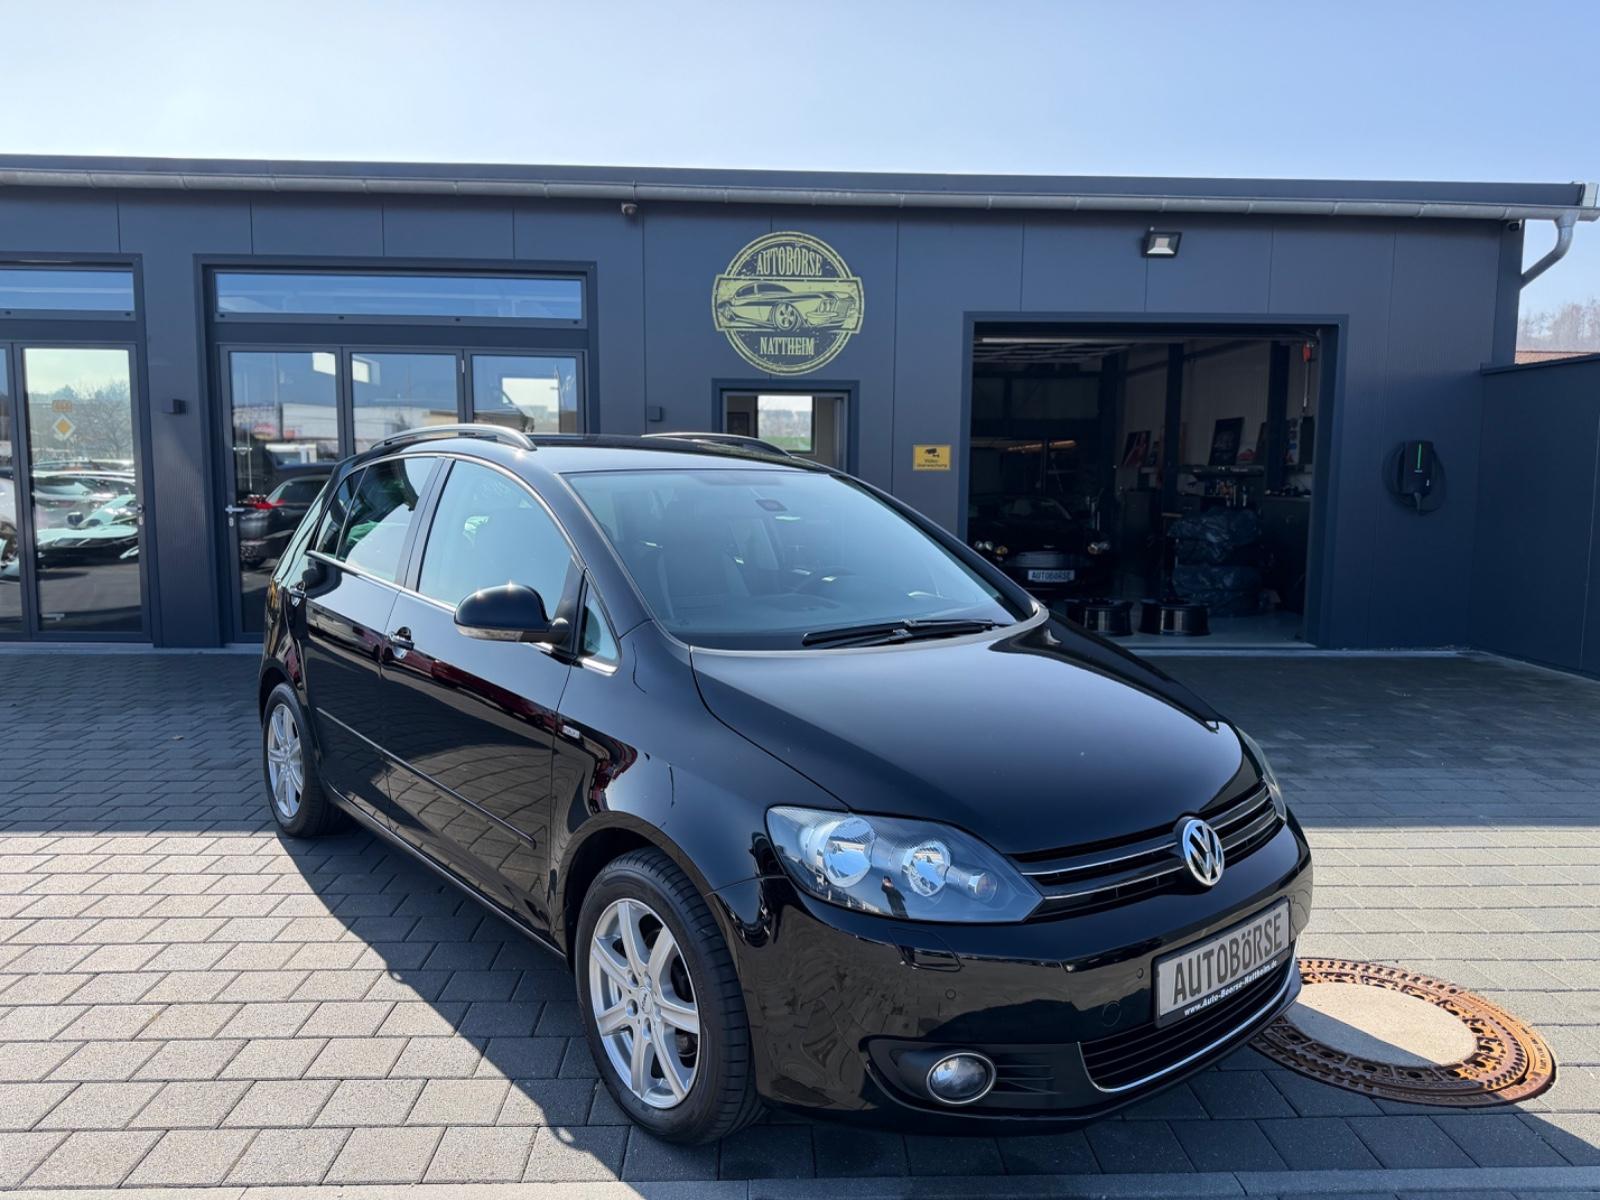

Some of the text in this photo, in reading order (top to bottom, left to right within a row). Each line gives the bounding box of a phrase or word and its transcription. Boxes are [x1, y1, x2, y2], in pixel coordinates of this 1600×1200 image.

[760, 336, 815, 355] NATTHEIM
[1173, 912, 1283, 1005] AUTOBÖRSE
[1183, 960, 1278, 1016] www.Auto-Boerse-Nattheim.de
